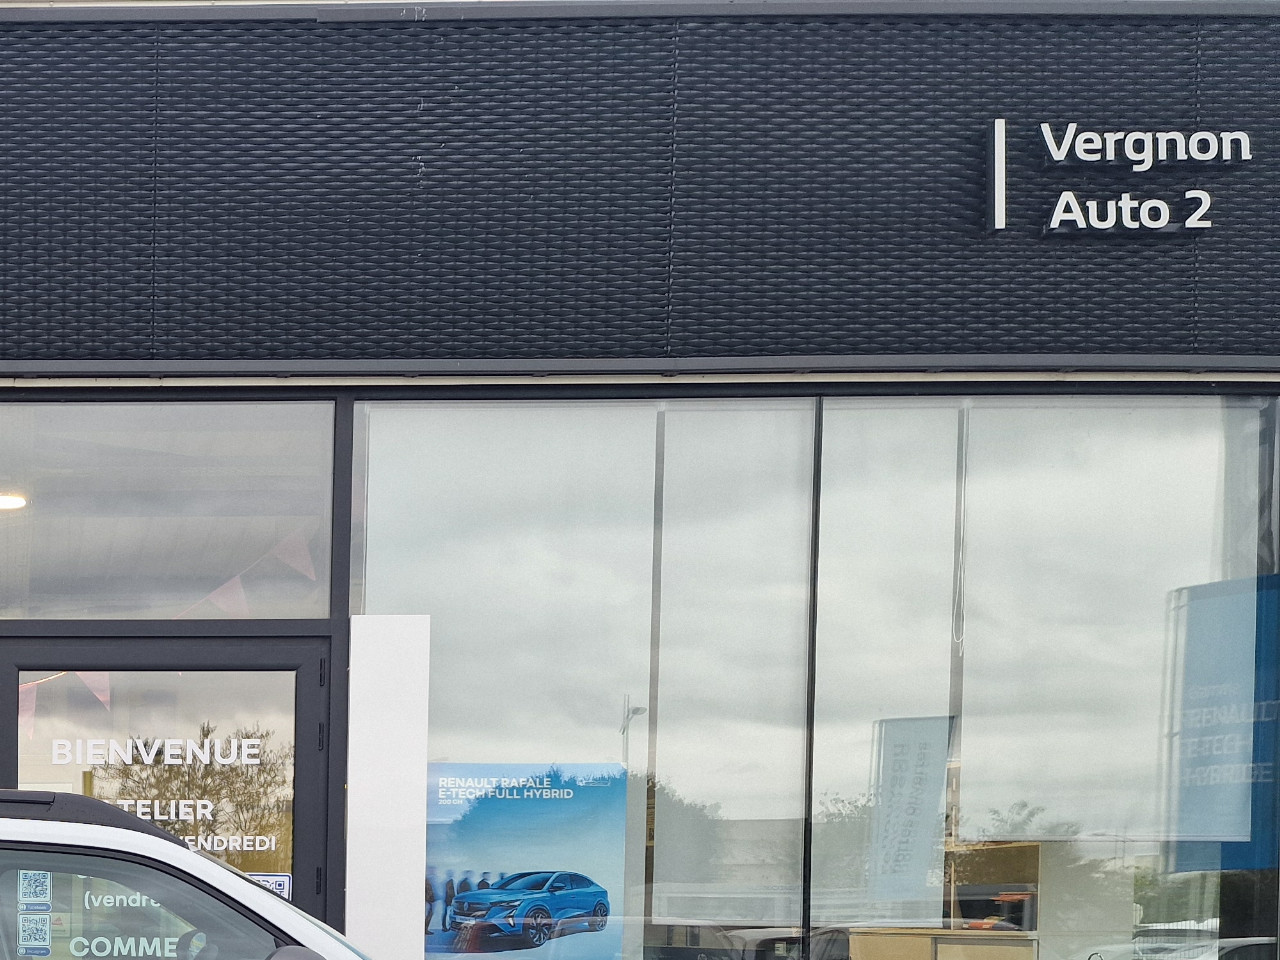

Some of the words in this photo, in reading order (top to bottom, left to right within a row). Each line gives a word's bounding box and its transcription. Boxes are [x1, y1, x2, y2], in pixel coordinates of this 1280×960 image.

[1040, 123, 1253, 172] Vergnon
[1049, 191, 1170, 229] Auto
[1184, 190, 1212, 228] 2
[51, 738, 261, 765] BIENVENUE
[439, 777, 499, 788] RENAULT
[501, 778, 552, 788] RAFALE
[439, 788, 487, 799] E-TECH
[488, 789, 521, 799] FULL
[524, 789, 574, 799] HYBRID
[116, 799, 214, 820] TELIER
[179, 835, 276, 851] ENDREDI
